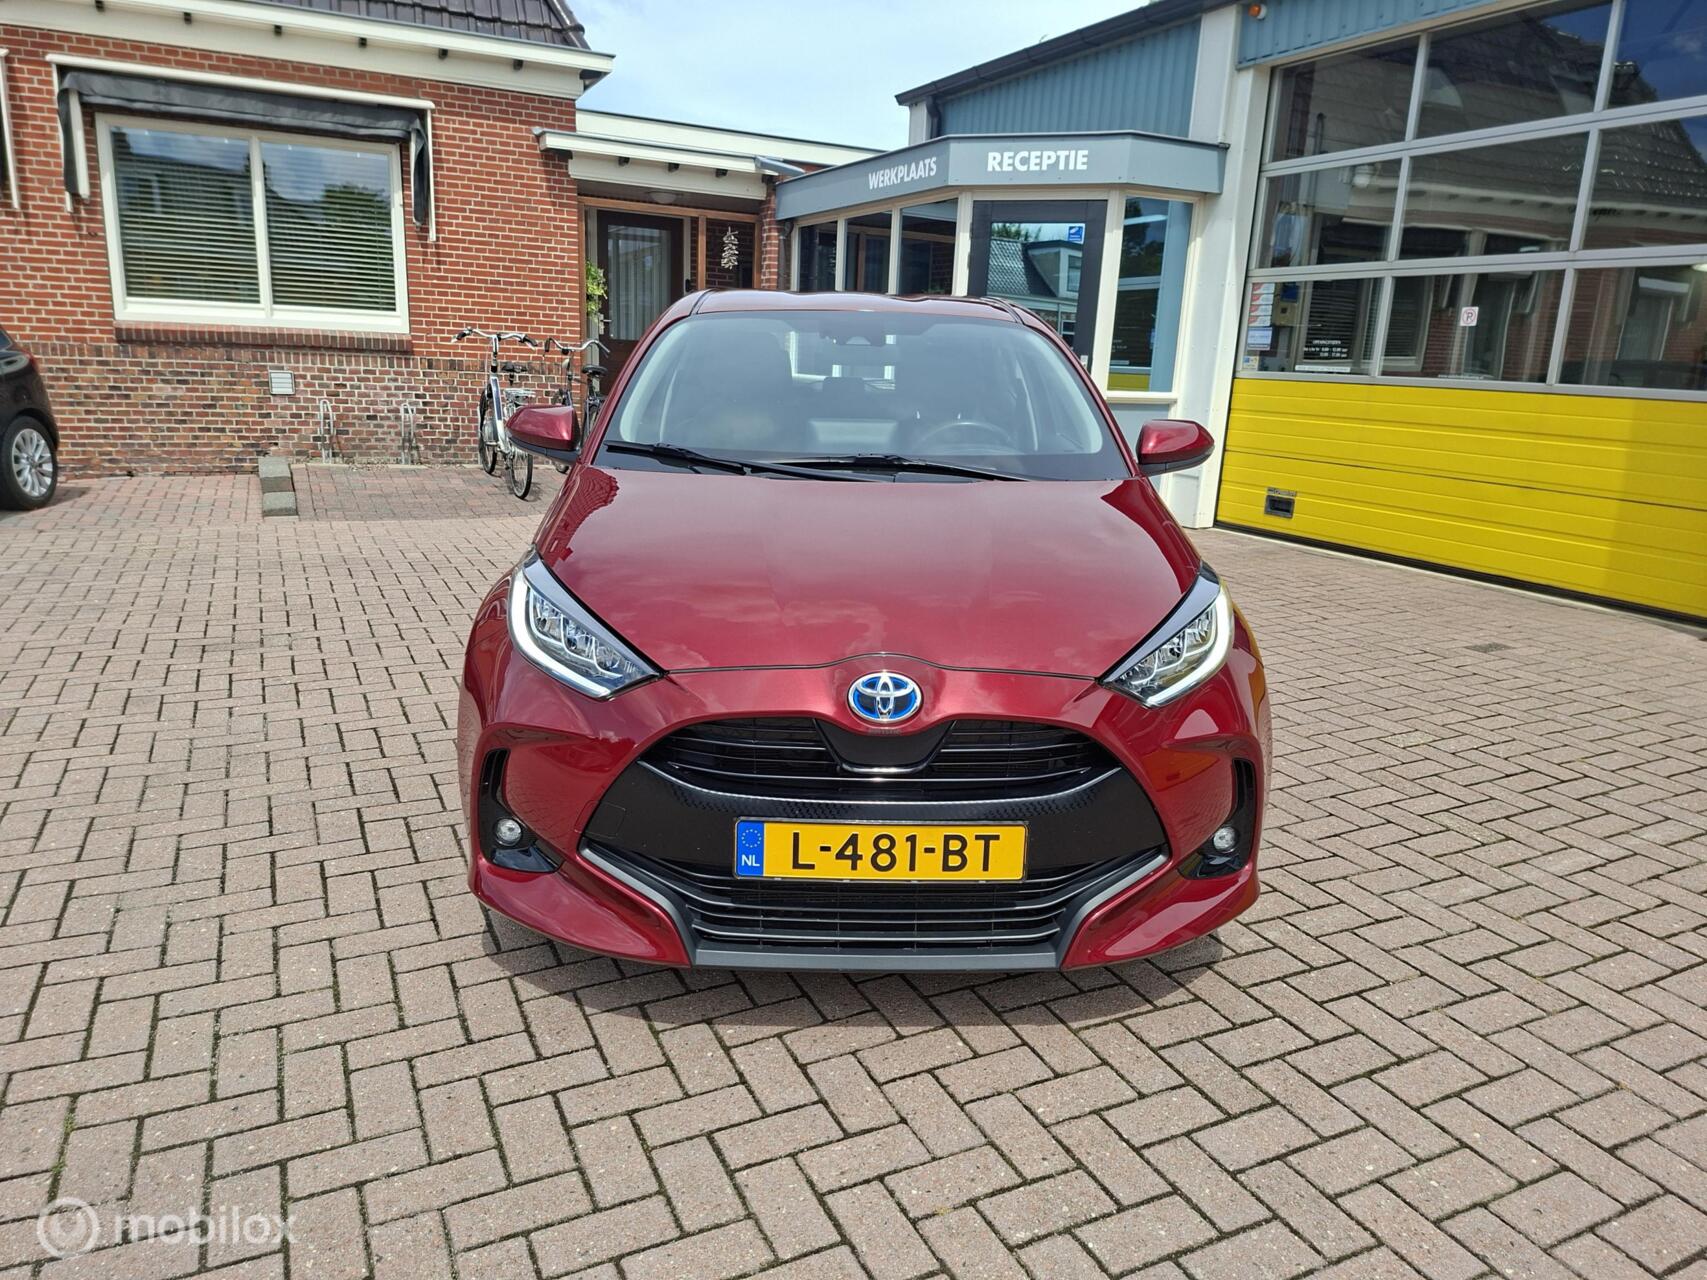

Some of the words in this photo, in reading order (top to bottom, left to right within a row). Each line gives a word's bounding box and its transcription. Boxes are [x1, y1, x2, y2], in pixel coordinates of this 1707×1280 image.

[868, 157, 937, 189] WERKPLAATS
[987, 150, 1089, 172] RECEPTIE
[741, 855, 760, 867] NL
[792, 832, 1000, 872] L-481-BT
